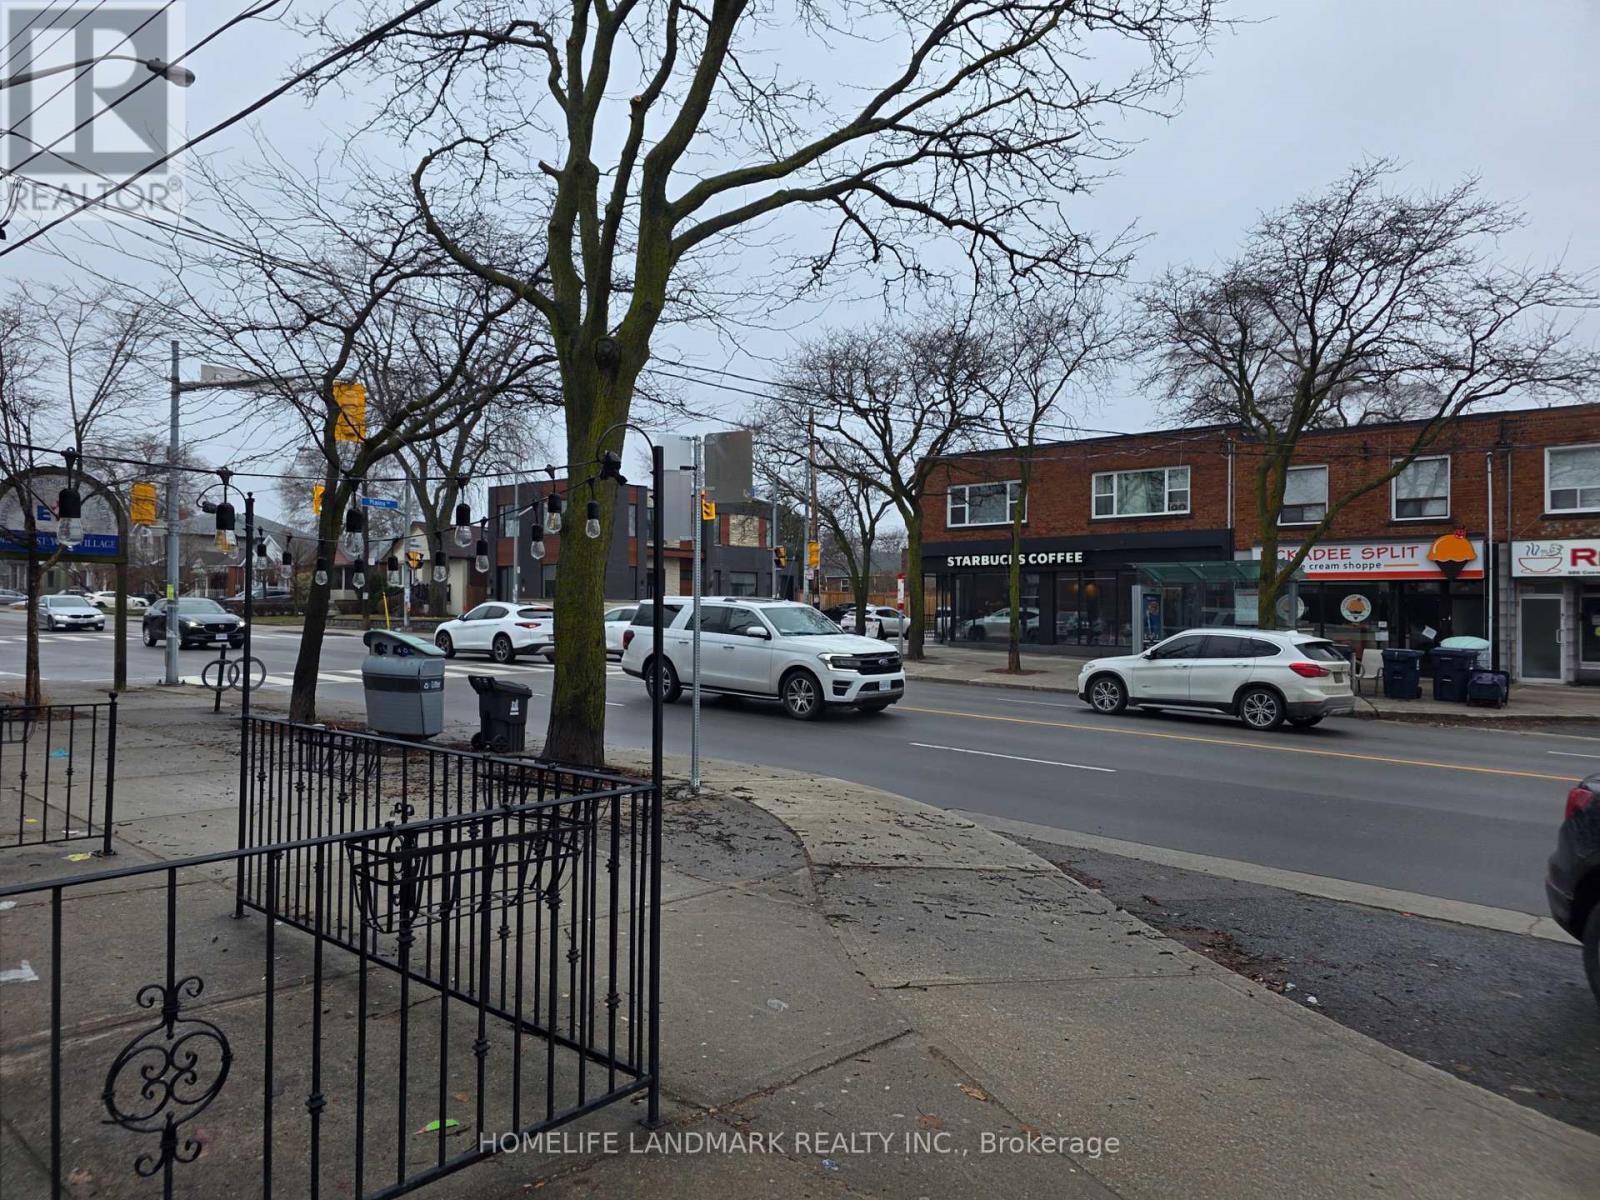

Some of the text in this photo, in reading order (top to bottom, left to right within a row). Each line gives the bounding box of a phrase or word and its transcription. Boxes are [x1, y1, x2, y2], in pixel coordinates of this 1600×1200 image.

[80, 539, 117, 549] ILLAGE
[1028, 552, 1083, 565] COFFEE
[1361, 546, 1419, 560] SPLIT
[1308, 563, 1340, 571] cream
[1343, 561, 1382, 571] shoppe
